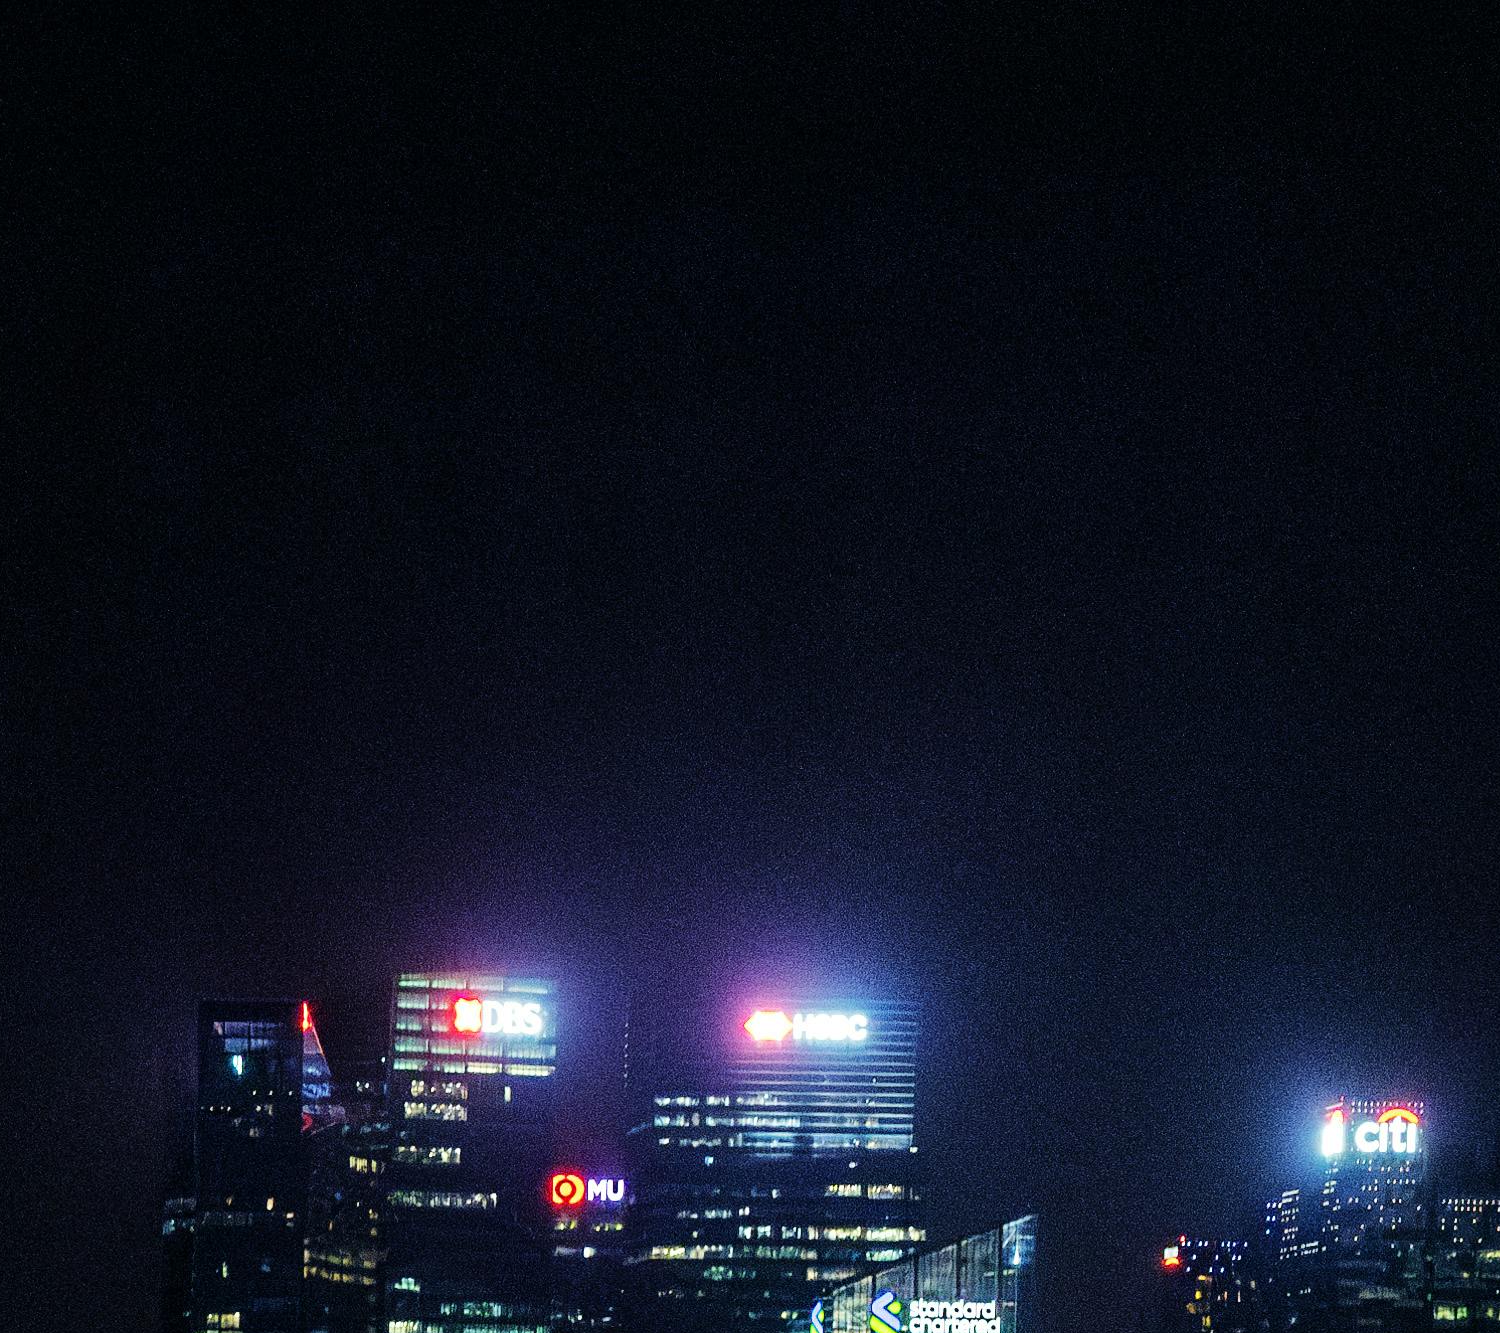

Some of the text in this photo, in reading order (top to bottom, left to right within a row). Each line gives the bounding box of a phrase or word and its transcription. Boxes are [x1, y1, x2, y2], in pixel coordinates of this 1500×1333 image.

[482, 1000, 542, 1034] DBS
[1354, 1115, 1417, 1153] citi
[909, 1297, 996, 1319] standard
